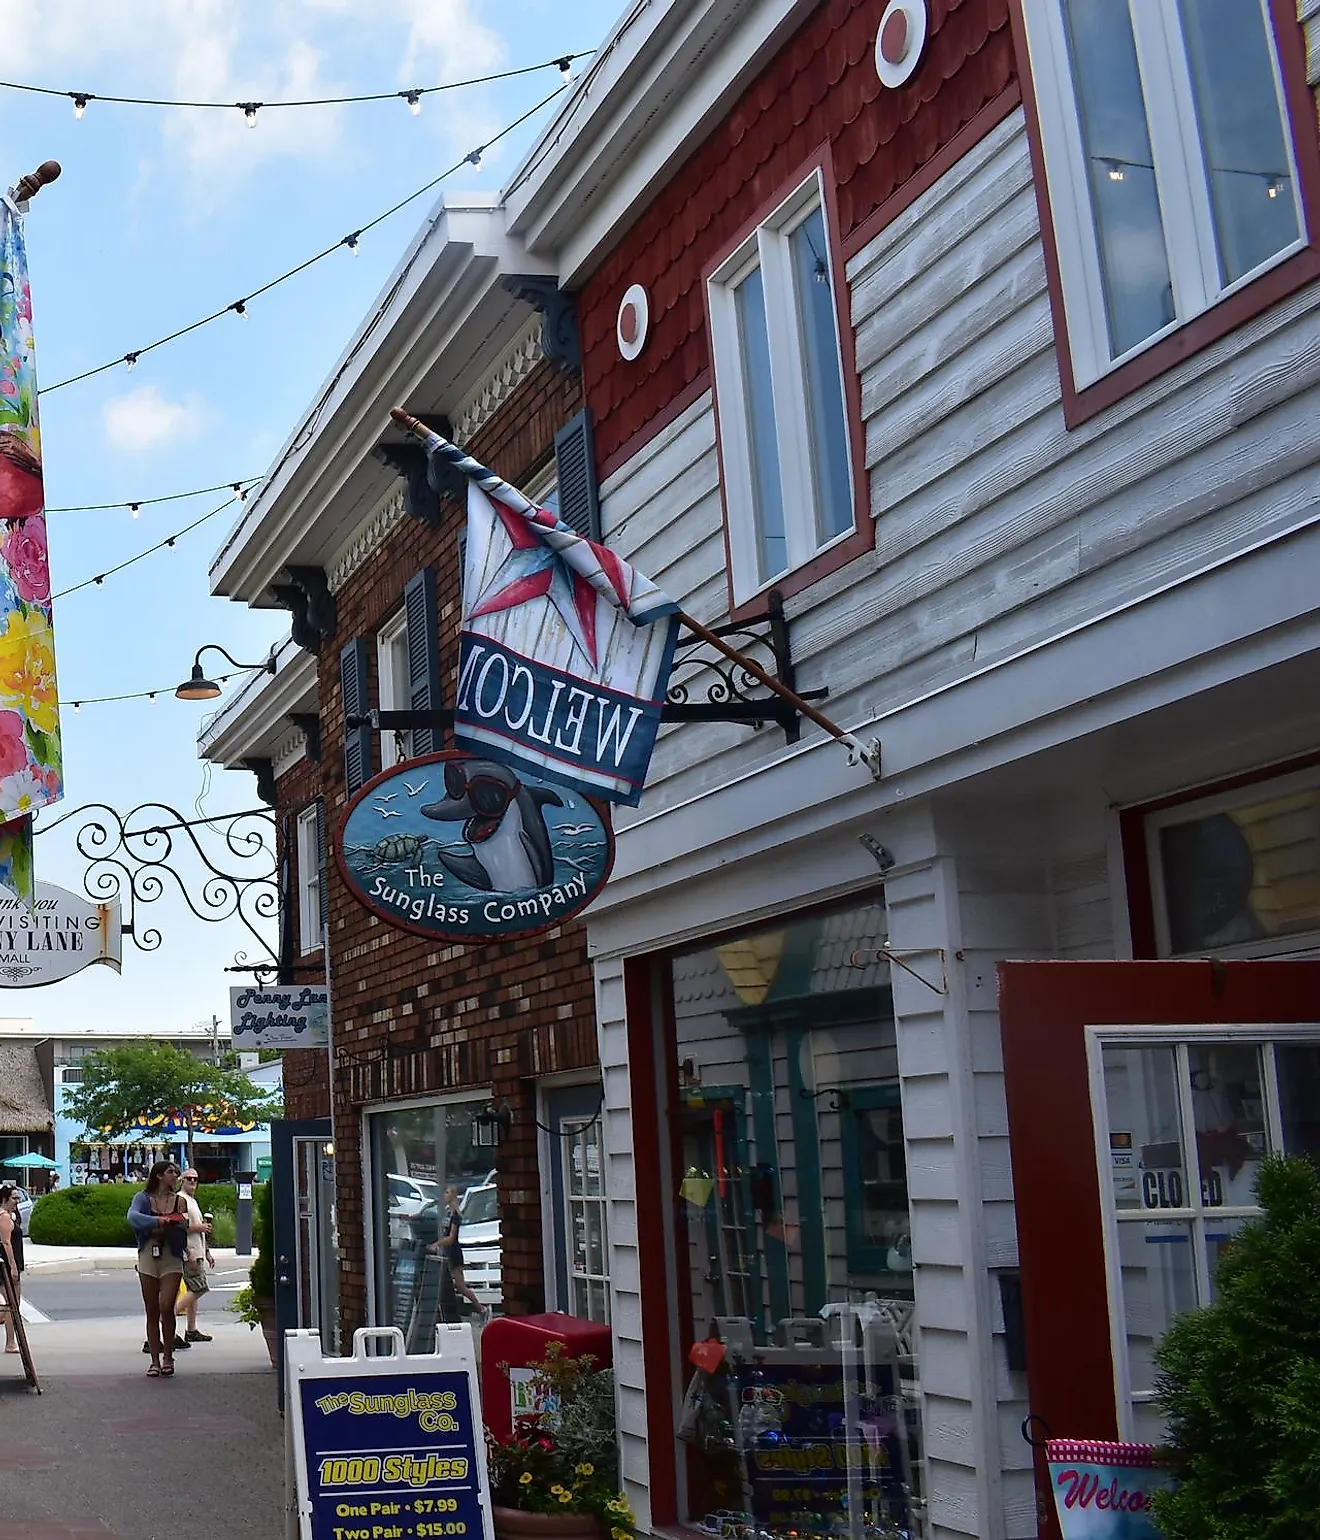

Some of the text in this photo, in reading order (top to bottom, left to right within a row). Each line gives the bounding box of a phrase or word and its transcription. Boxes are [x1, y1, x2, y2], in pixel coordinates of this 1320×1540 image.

[405, 868, 445, 888] The
[369, 872, 589, 924] Sunglass Company
[27, 930, 84, 951] LANE
[236, 987, 328, 1011] Penny Lan
[233, 1011, 308, 1035] Lighting
[1113, 1157, 1131, 1165] VISA
[1143, 1170, 1223, 1209] CLOED
[315, 1388, 457, 1418] The Sunglass
[419, 1410, 459, 1432] Co.
[318, 1453, 468, 1487] 1000 Styles
[335, 1498, 458, 1518] One Pair $7.99
[332, 1522, 467, 1540] Two Pair $15.00
